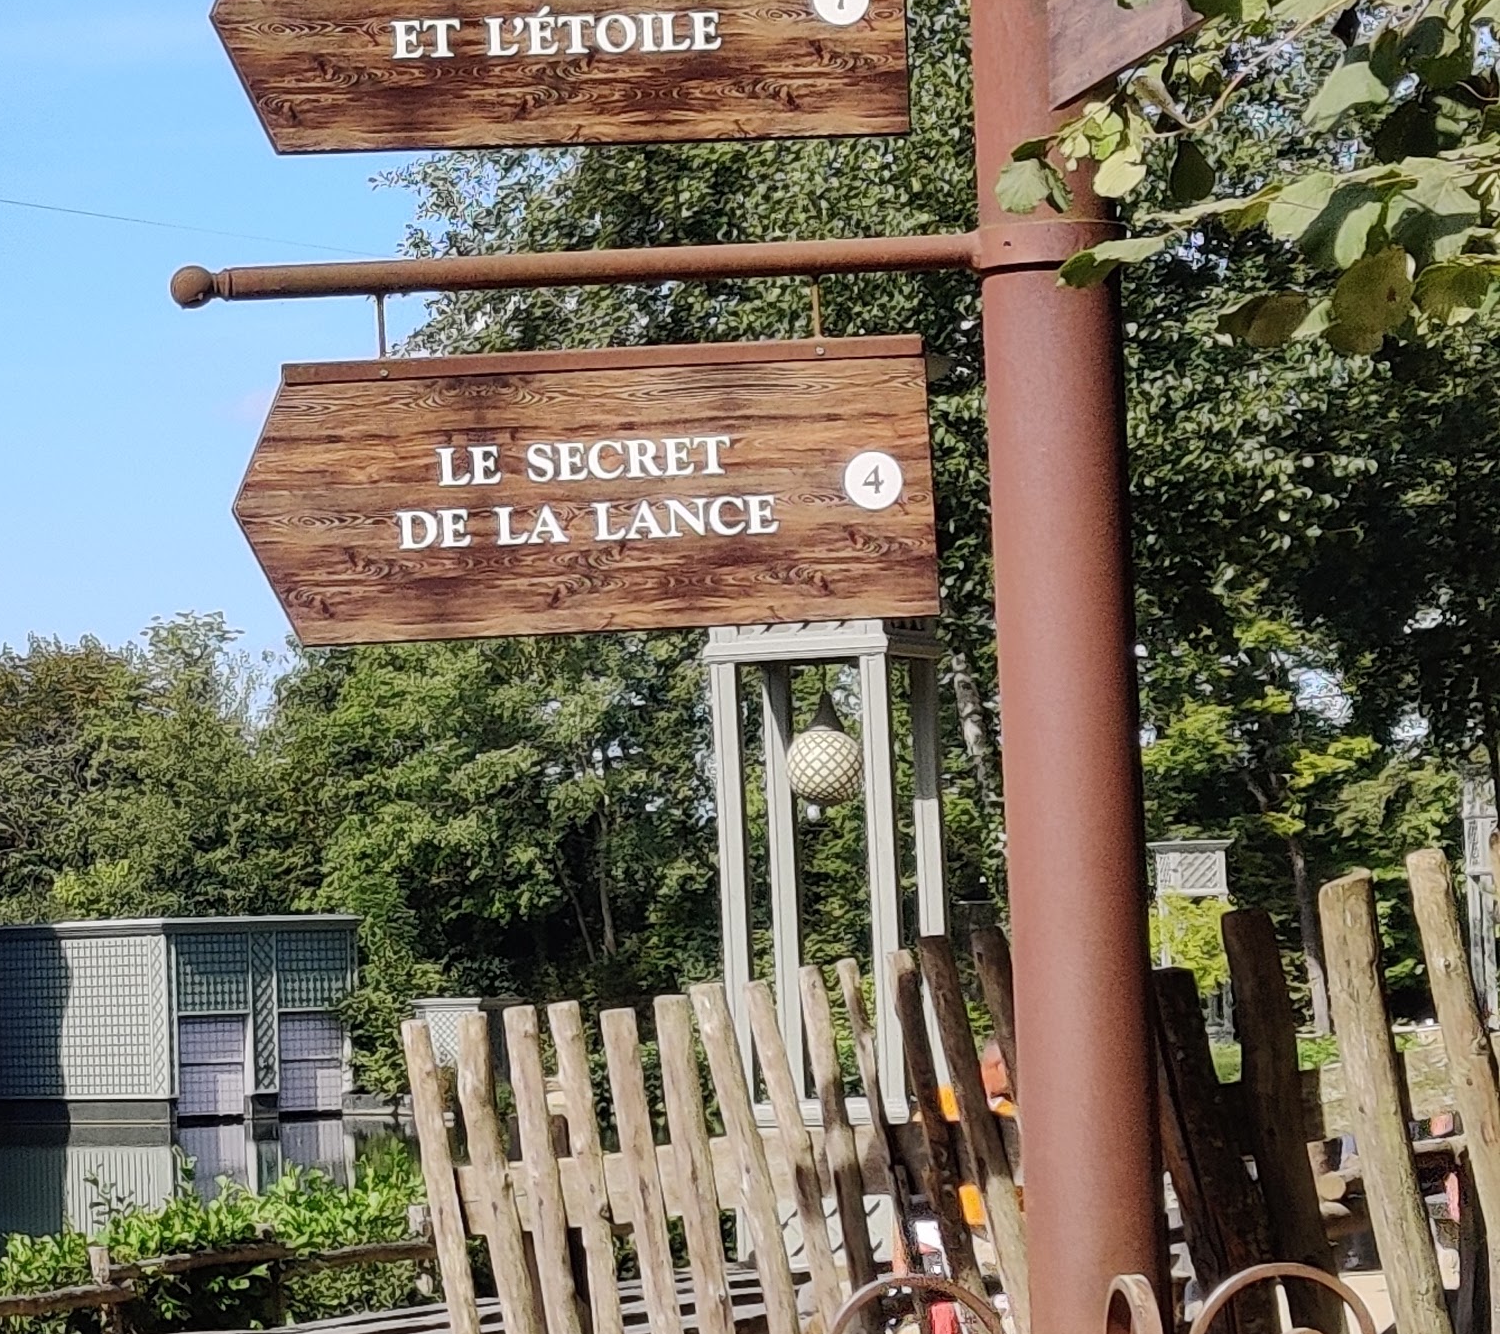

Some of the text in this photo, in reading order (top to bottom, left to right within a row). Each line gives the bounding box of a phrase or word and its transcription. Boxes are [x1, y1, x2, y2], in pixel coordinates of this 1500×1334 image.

[390, 5, 722, 59] ET L'ÉTOILE
[435, 435, 730, 486] LE SECRET
[862, 465, 885, 494] 4
[395, 494, 779, 549] DE LA LANCE
